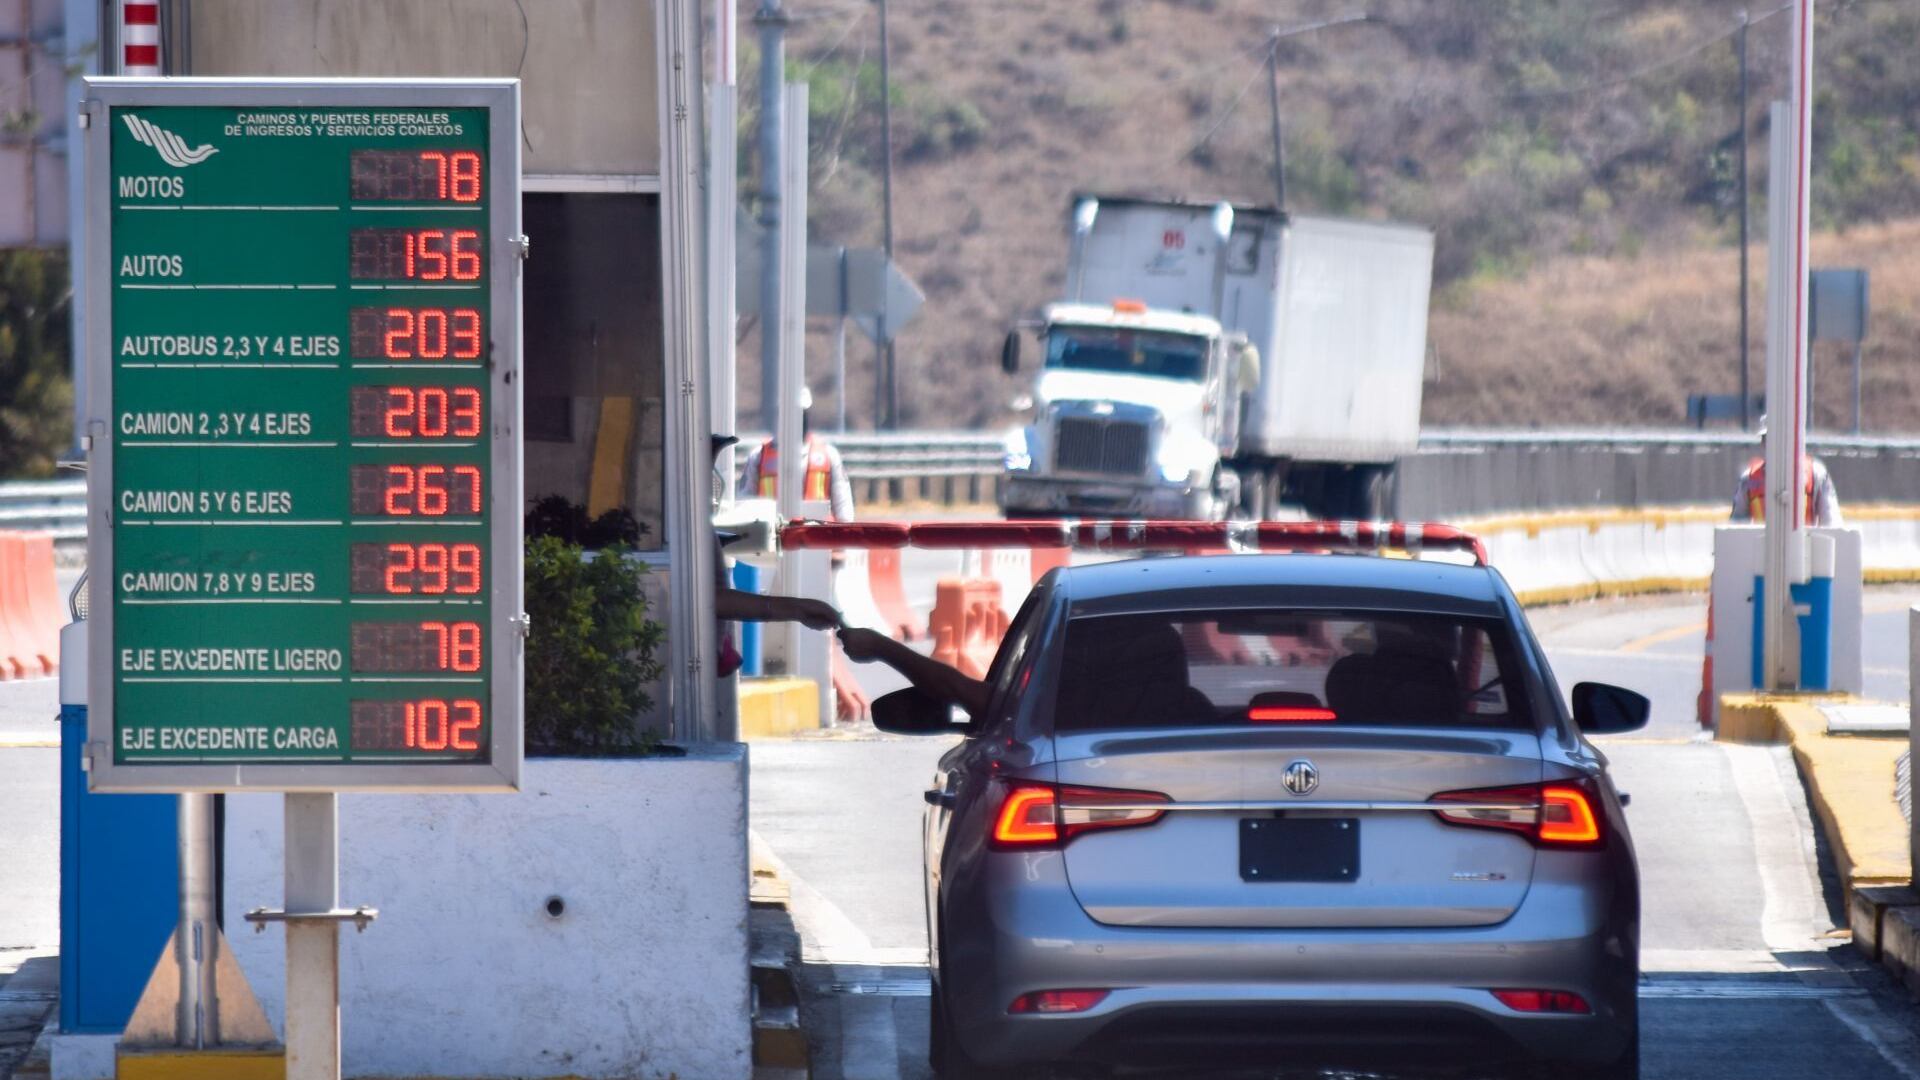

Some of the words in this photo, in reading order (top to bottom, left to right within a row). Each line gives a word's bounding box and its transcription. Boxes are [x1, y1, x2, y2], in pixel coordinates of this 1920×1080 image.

[224, 125, 242, 136] DE
[246, 125, 312, 136] INGRESOS
[315, 125, 324, 136] Y
[327, 125, 396, 136] SERVICIOS
[399, 124, 463, 136] CONEXOS
[237, 113, 297, 125] CAMINOS
[299, 113, 308, 124] Y
[311, 113, 371, 125] PUENTES
[373, 113, 449, 125] FEDERALES
[119, 176, 184, 198] MOTOS
[420, 151, 481, 202] 78
[120, 255, 183, 277] AUTOS
[405, 230, 481, 280] 156
[384, 308, 481, 358] 203
[121, 335, 218, 356] AUTOBUS
[223, 336, 250, 361] 2,3
[255, 336, 268, 356] Y
[273, 336, 285, 356] 4
[290, 336, 340, 356] EJES
[121, 412, 193, 435] CAMION
[233, 413, 246, 435] Y
[249, 413, 261, 435] 4
[265, 413, 311, 435] EJES
[384, 386, 481, 437] 203
[121, 490, 194, 513] CAMION
[199, 491, 210, 513] 5
[214, 491, 227, 512] Y
[230, 491, 241, 513] 6
[246, 491, 292, 514] EJES
[384, 464, 481, 516] 267
[384, 543, 481, 594] 299
[121, 572, 198, 593] CAMION
[203, 573, 230, 597] 7,8
[233, 573, 246, 592] Y
[251, 573, 262, 592] 9
[267, 572, 315, 593] EJES
[121, 649, 155, 671] EJE
[160, 648, 269, 671] EXCEDENTE
[274, 648, 342, 671] LIGERO
[420, 621, 481, 672] 78
[405, 700, 481, 750] 102
[122, 727, 155, 750] EJE
[160, 727, 269, 750] EXCEDENTE
[273, 727, 338, 749] CARGA
[1285, 762, 1317, 793] MG
